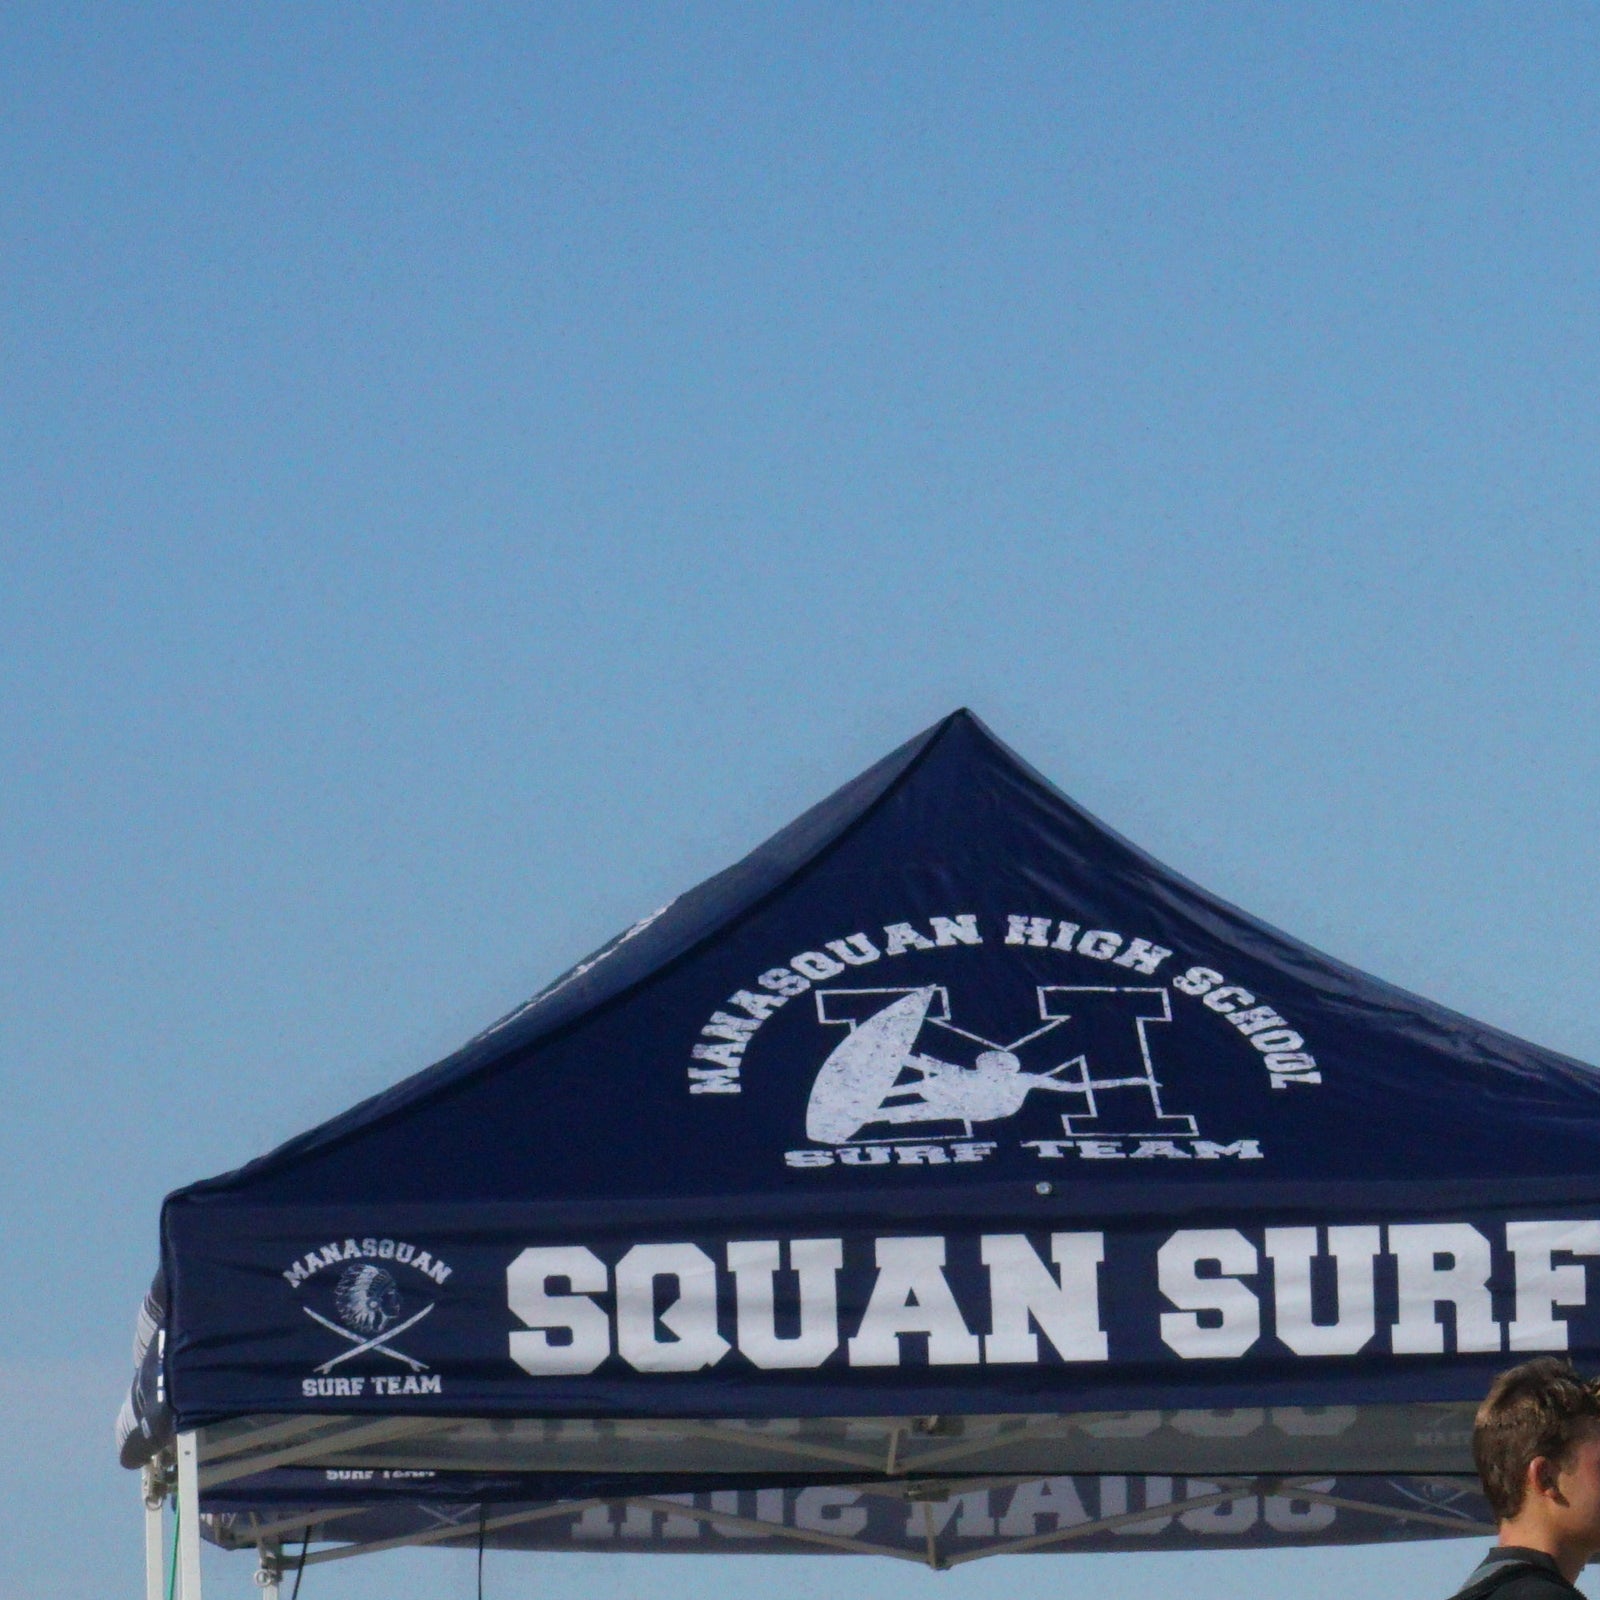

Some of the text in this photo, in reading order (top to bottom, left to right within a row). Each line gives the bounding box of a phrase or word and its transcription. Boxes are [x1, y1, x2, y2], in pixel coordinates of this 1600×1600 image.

[688, 914, 1322, 1094] MANASQUAN HIGH SCHOOL
[785, 1137, 1264, 1168] SURF TEAM
[283, 1238, 453, 1289] MANASQUAN
[506, 1231, 1109, 1376] SQUAN
[302, 1375, 442, 1397] SURF TEAM
